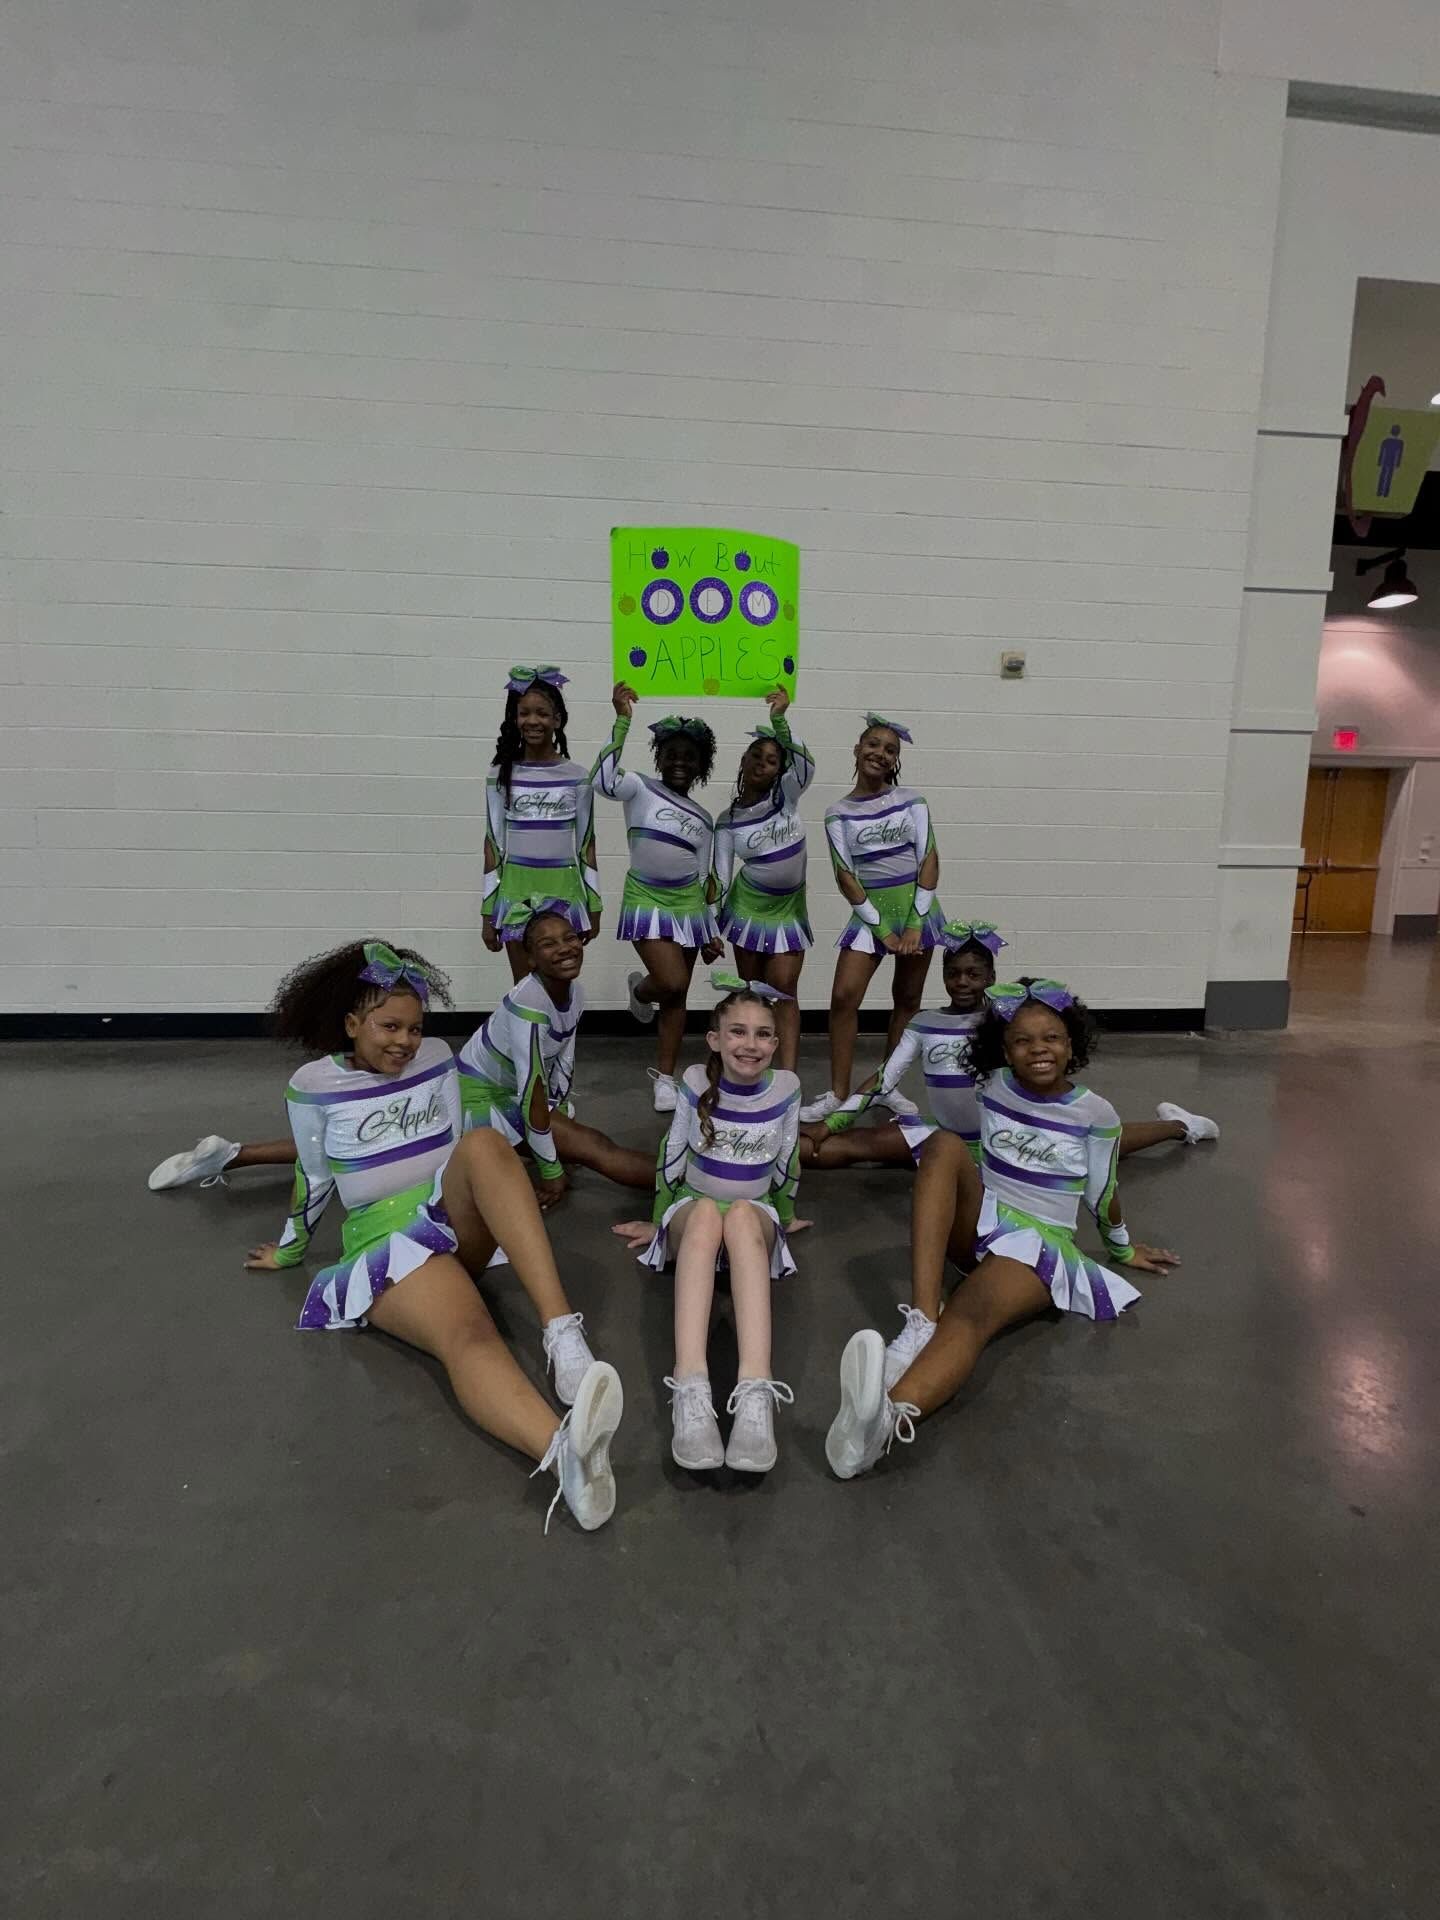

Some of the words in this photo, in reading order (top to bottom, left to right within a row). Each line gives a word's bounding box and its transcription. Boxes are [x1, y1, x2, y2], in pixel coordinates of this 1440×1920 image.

[650, 636, 781, 682] APPLES
[513, 791, 567, 815] Apple
[655, 807, 705, 838] Apple
[746, 815, 799, 850] Apple
[856, 817, 913, 845] Apple
[356, 1093, 442, 1143] Apple
[713, 1129, 765, 1158] Apple
[989, 1128, 1059, 1163] Apple
